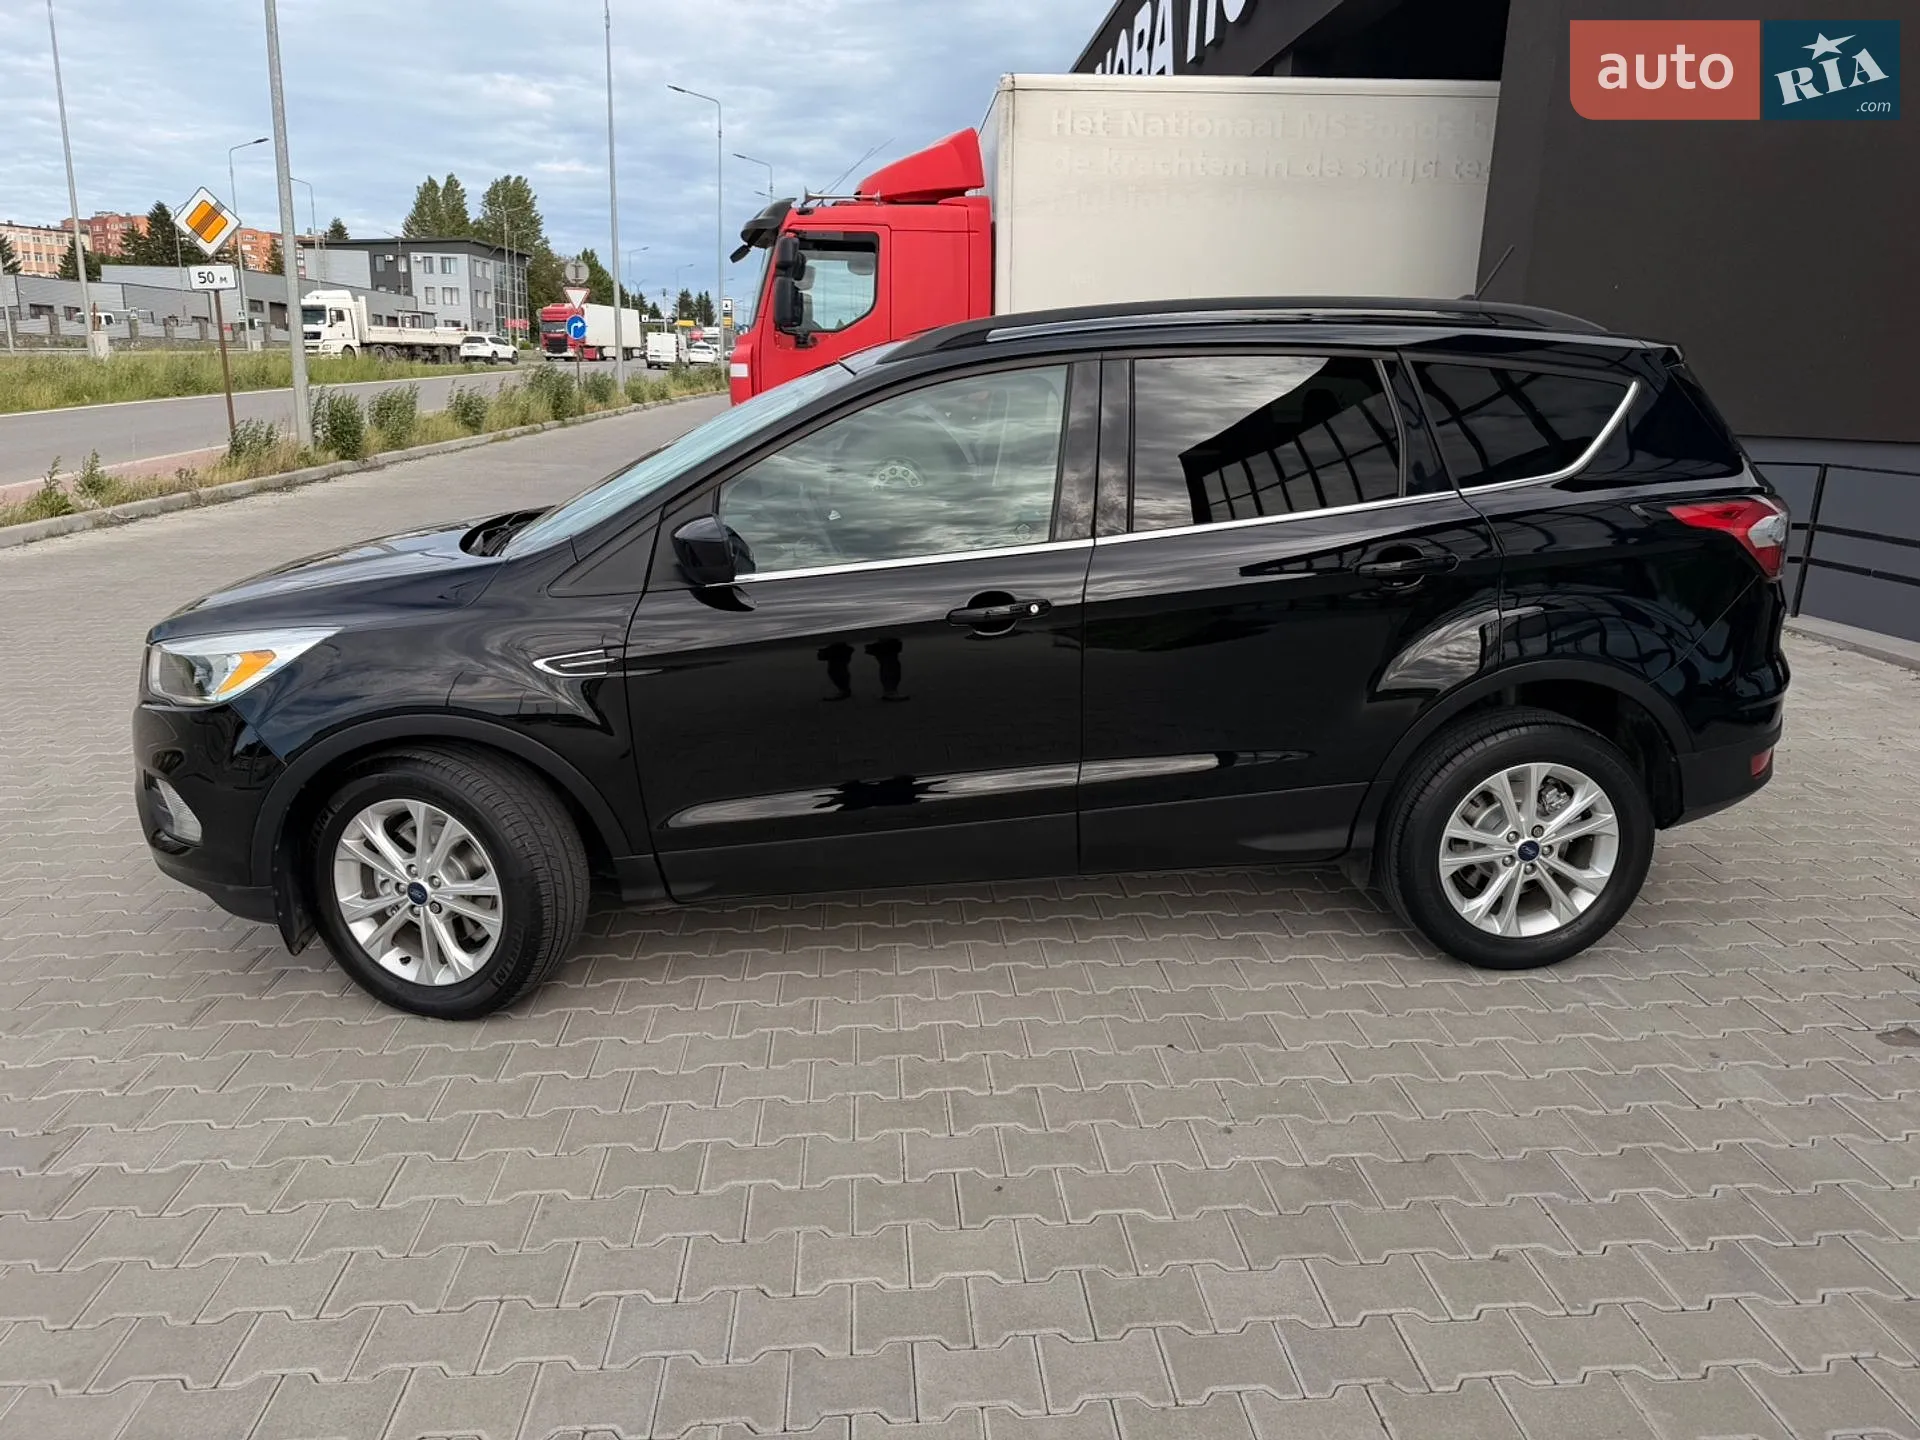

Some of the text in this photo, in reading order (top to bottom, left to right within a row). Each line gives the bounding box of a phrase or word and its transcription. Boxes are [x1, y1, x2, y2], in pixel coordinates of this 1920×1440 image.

[1095, 0, 1175, 75] ОВА
[1052, 107, 1112, 137] Het
[1121, 106, 1286, 138] Nationaal
[1260, 148, 1291, 178] in
[197, 270, 215, 284] 50
